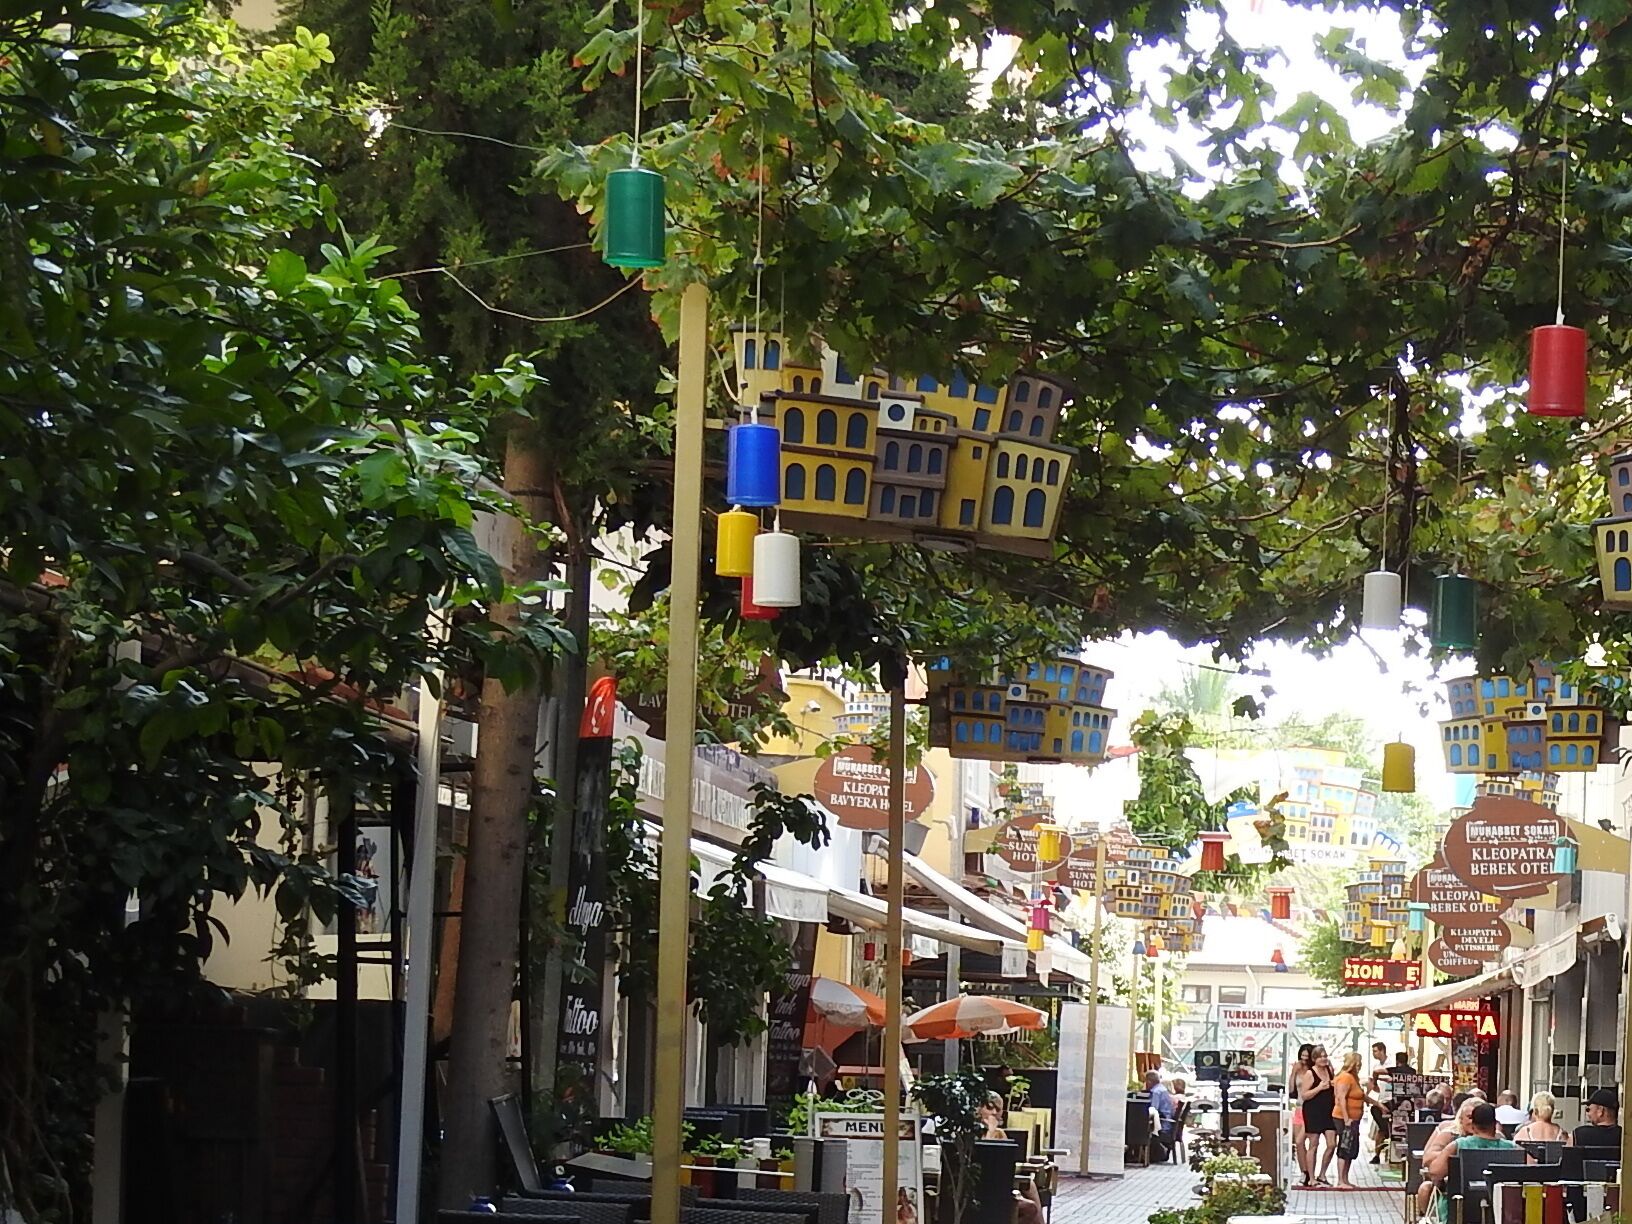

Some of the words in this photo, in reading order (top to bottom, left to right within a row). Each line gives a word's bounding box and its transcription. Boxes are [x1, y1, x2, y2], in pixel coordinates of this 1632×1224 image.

[830, 793, 877, 809] BAVYERA
[1470, 825, 1520, 836] MUHABBET
[1524, 825, 1555, 836] SOKAK
[1472, 848, 1555, 861] KLEOPATRA
[1471, 862, 1518, 875] BEBEK
[1431, 902, 1467, 913] BEBEK
[1469, 902, 1499, 913] OTEL
[1223, 1010, 1264, 1020] TURKISH
[1268, 1011, 1293, 1021] BATH
[1227, 1021, 1288, 1029] INFORMATION
